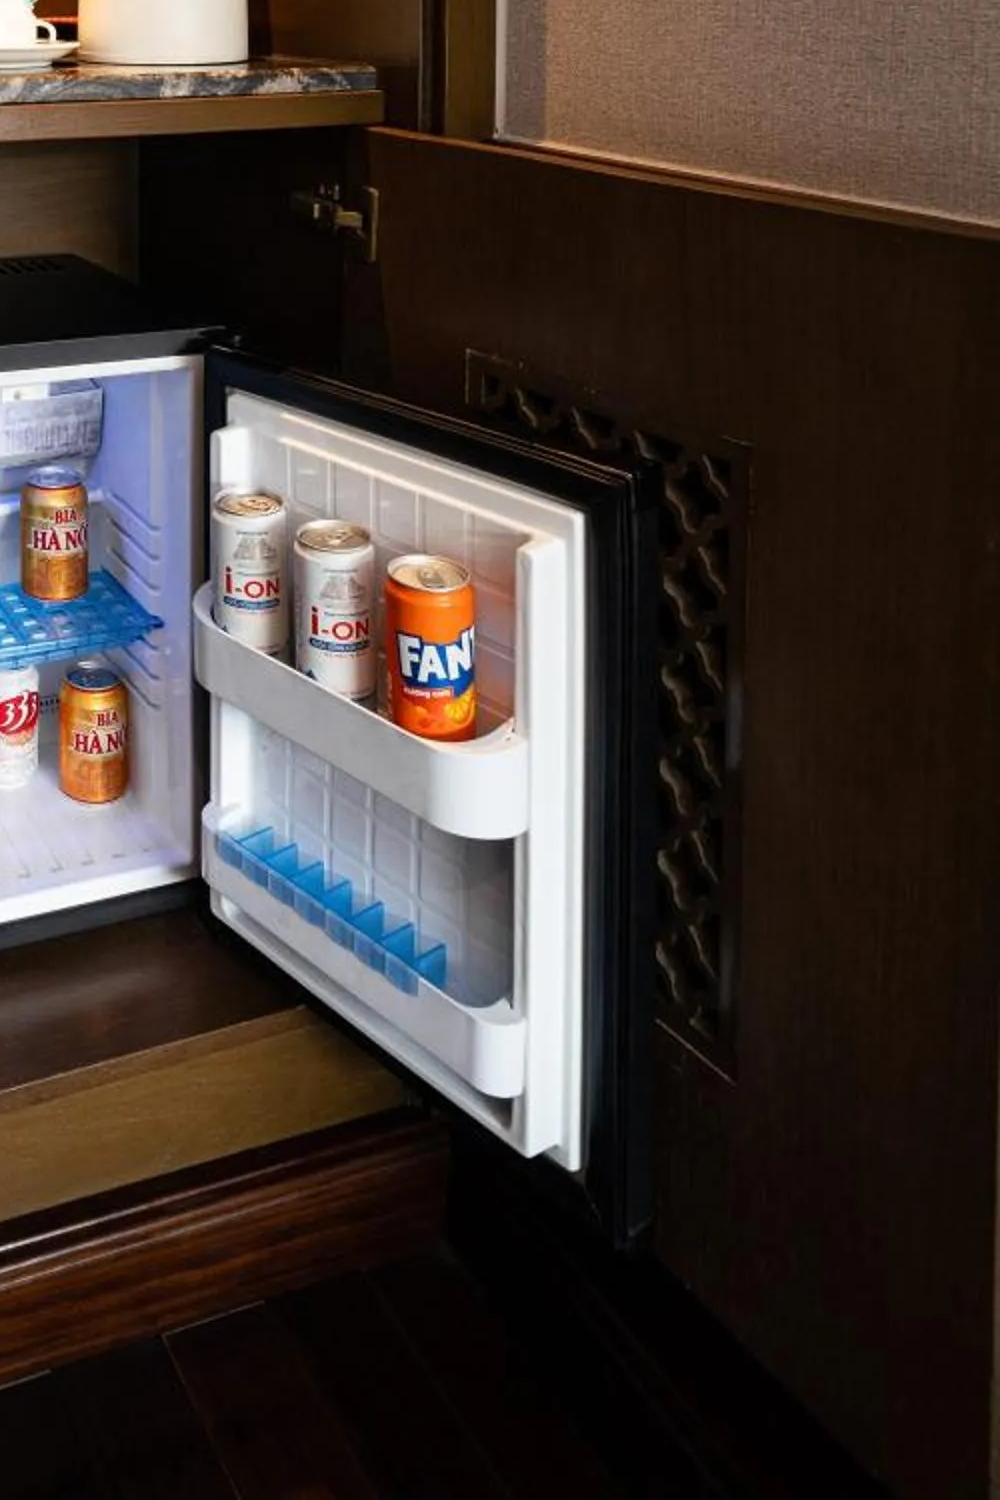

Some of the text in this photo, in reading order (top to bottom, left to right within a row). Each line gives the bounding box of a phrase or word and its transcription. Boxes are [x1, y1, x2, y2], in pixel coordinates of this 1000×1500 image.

[55, 508, 77, 524] BIA
[33, 526, 62, 551] HÀ
[224, 566, 280, 599] i-ON
[311, 606, 370, 640] i-ON
[0, 690, 38, 731] 333
[97, 710, 118, 726] BIA
[75, 730, 102, 754] HÀ
